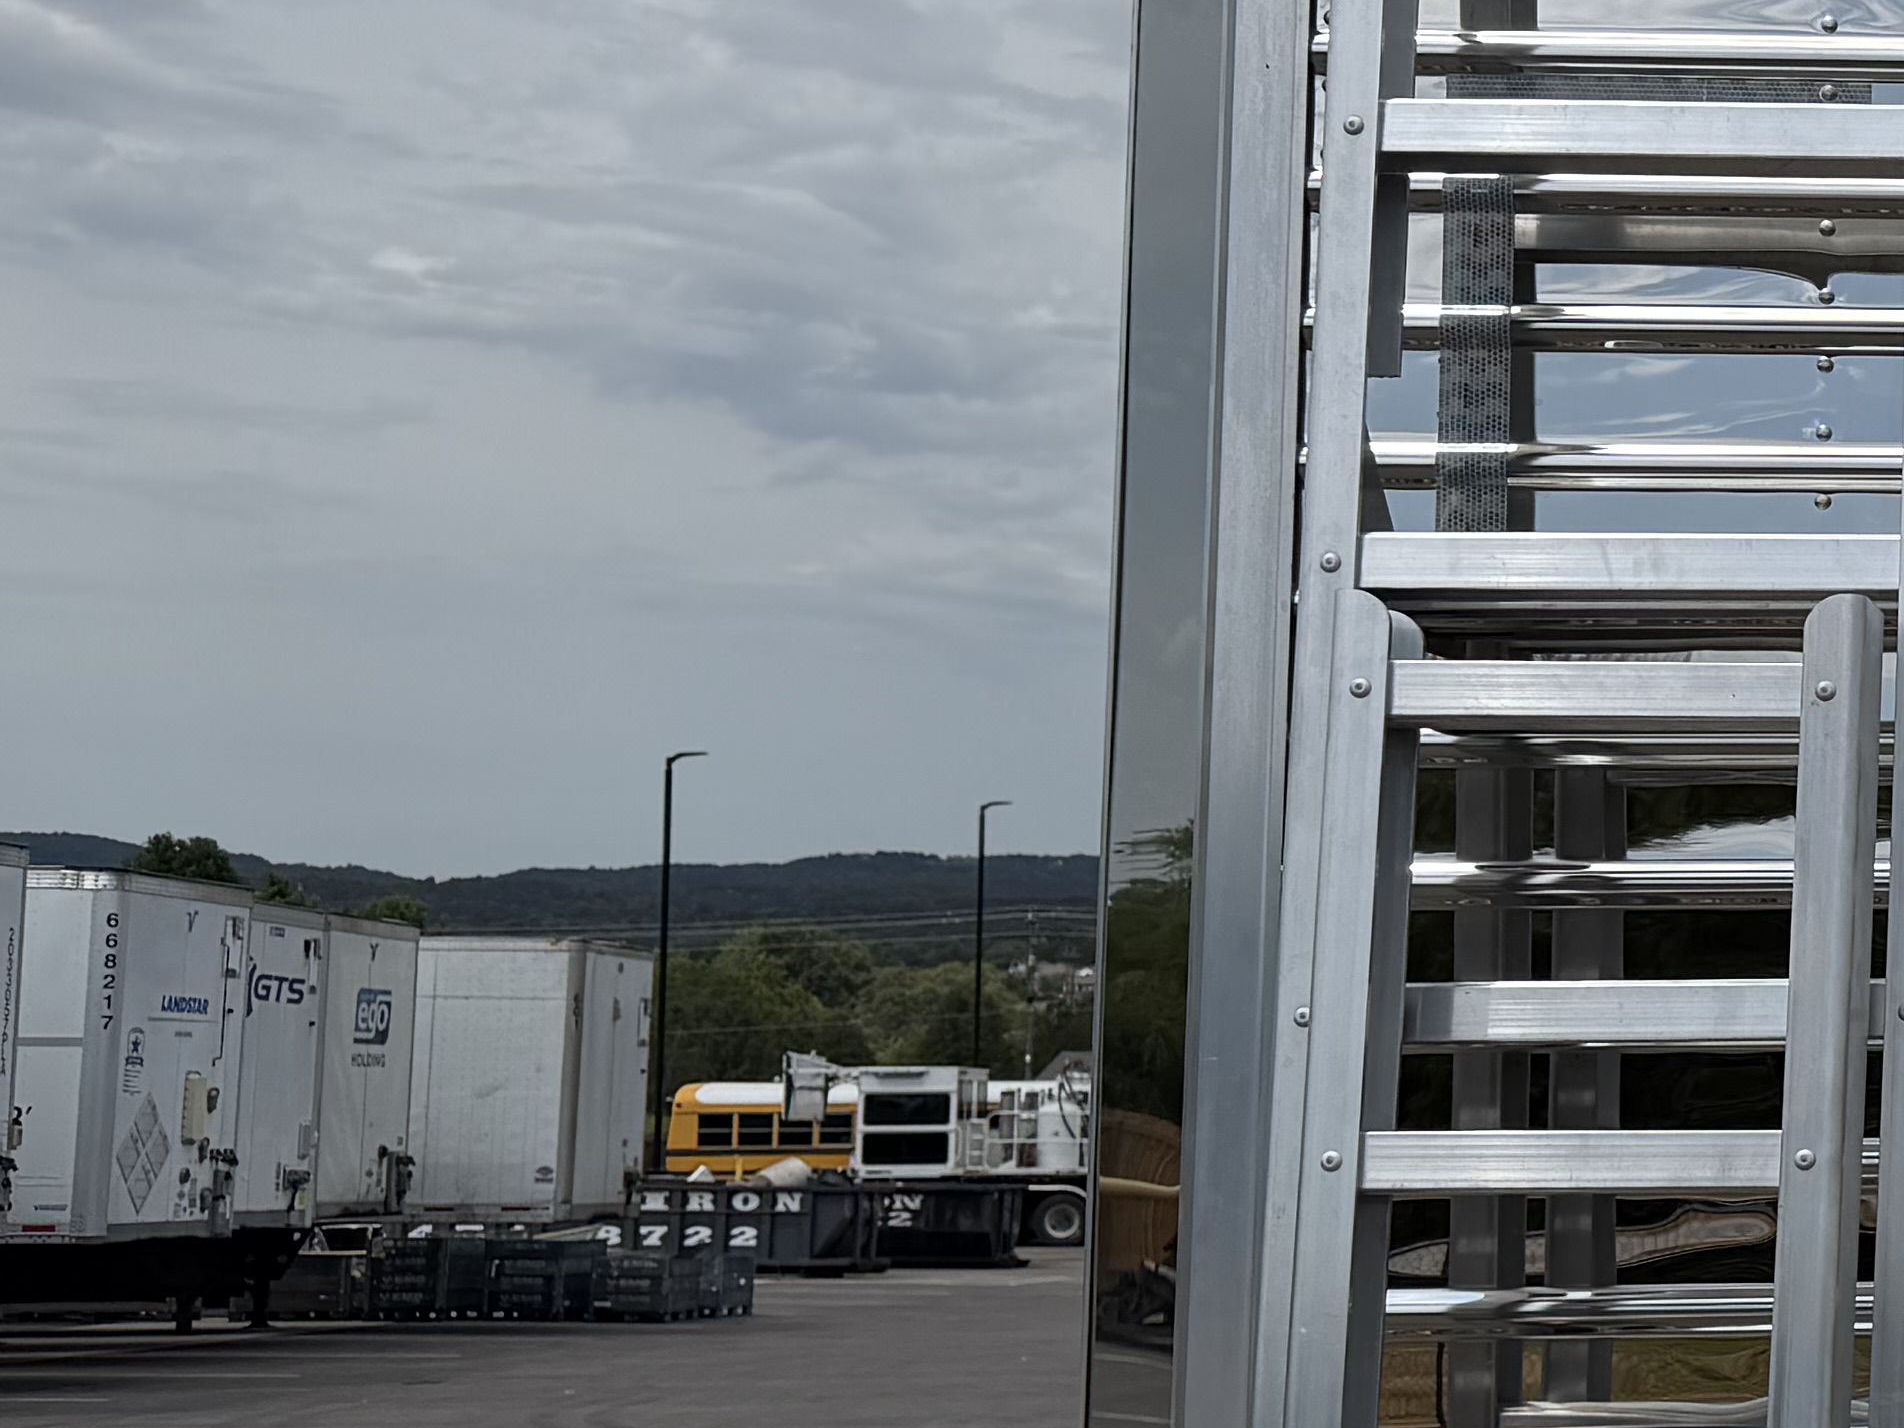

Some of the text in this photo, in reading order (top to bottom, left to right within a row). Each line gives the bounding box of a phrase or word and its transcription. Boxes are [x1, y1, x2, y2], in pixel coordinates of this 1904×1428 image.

[101, 912, 120, 1031] 668217
[253, 973, 306, 1005] GTS
[160, 994, 209, 1015] LANDSTAR
[351, 1053, 385, 1068] HOLDING
[640, 1190, 803, 1213] IRON
